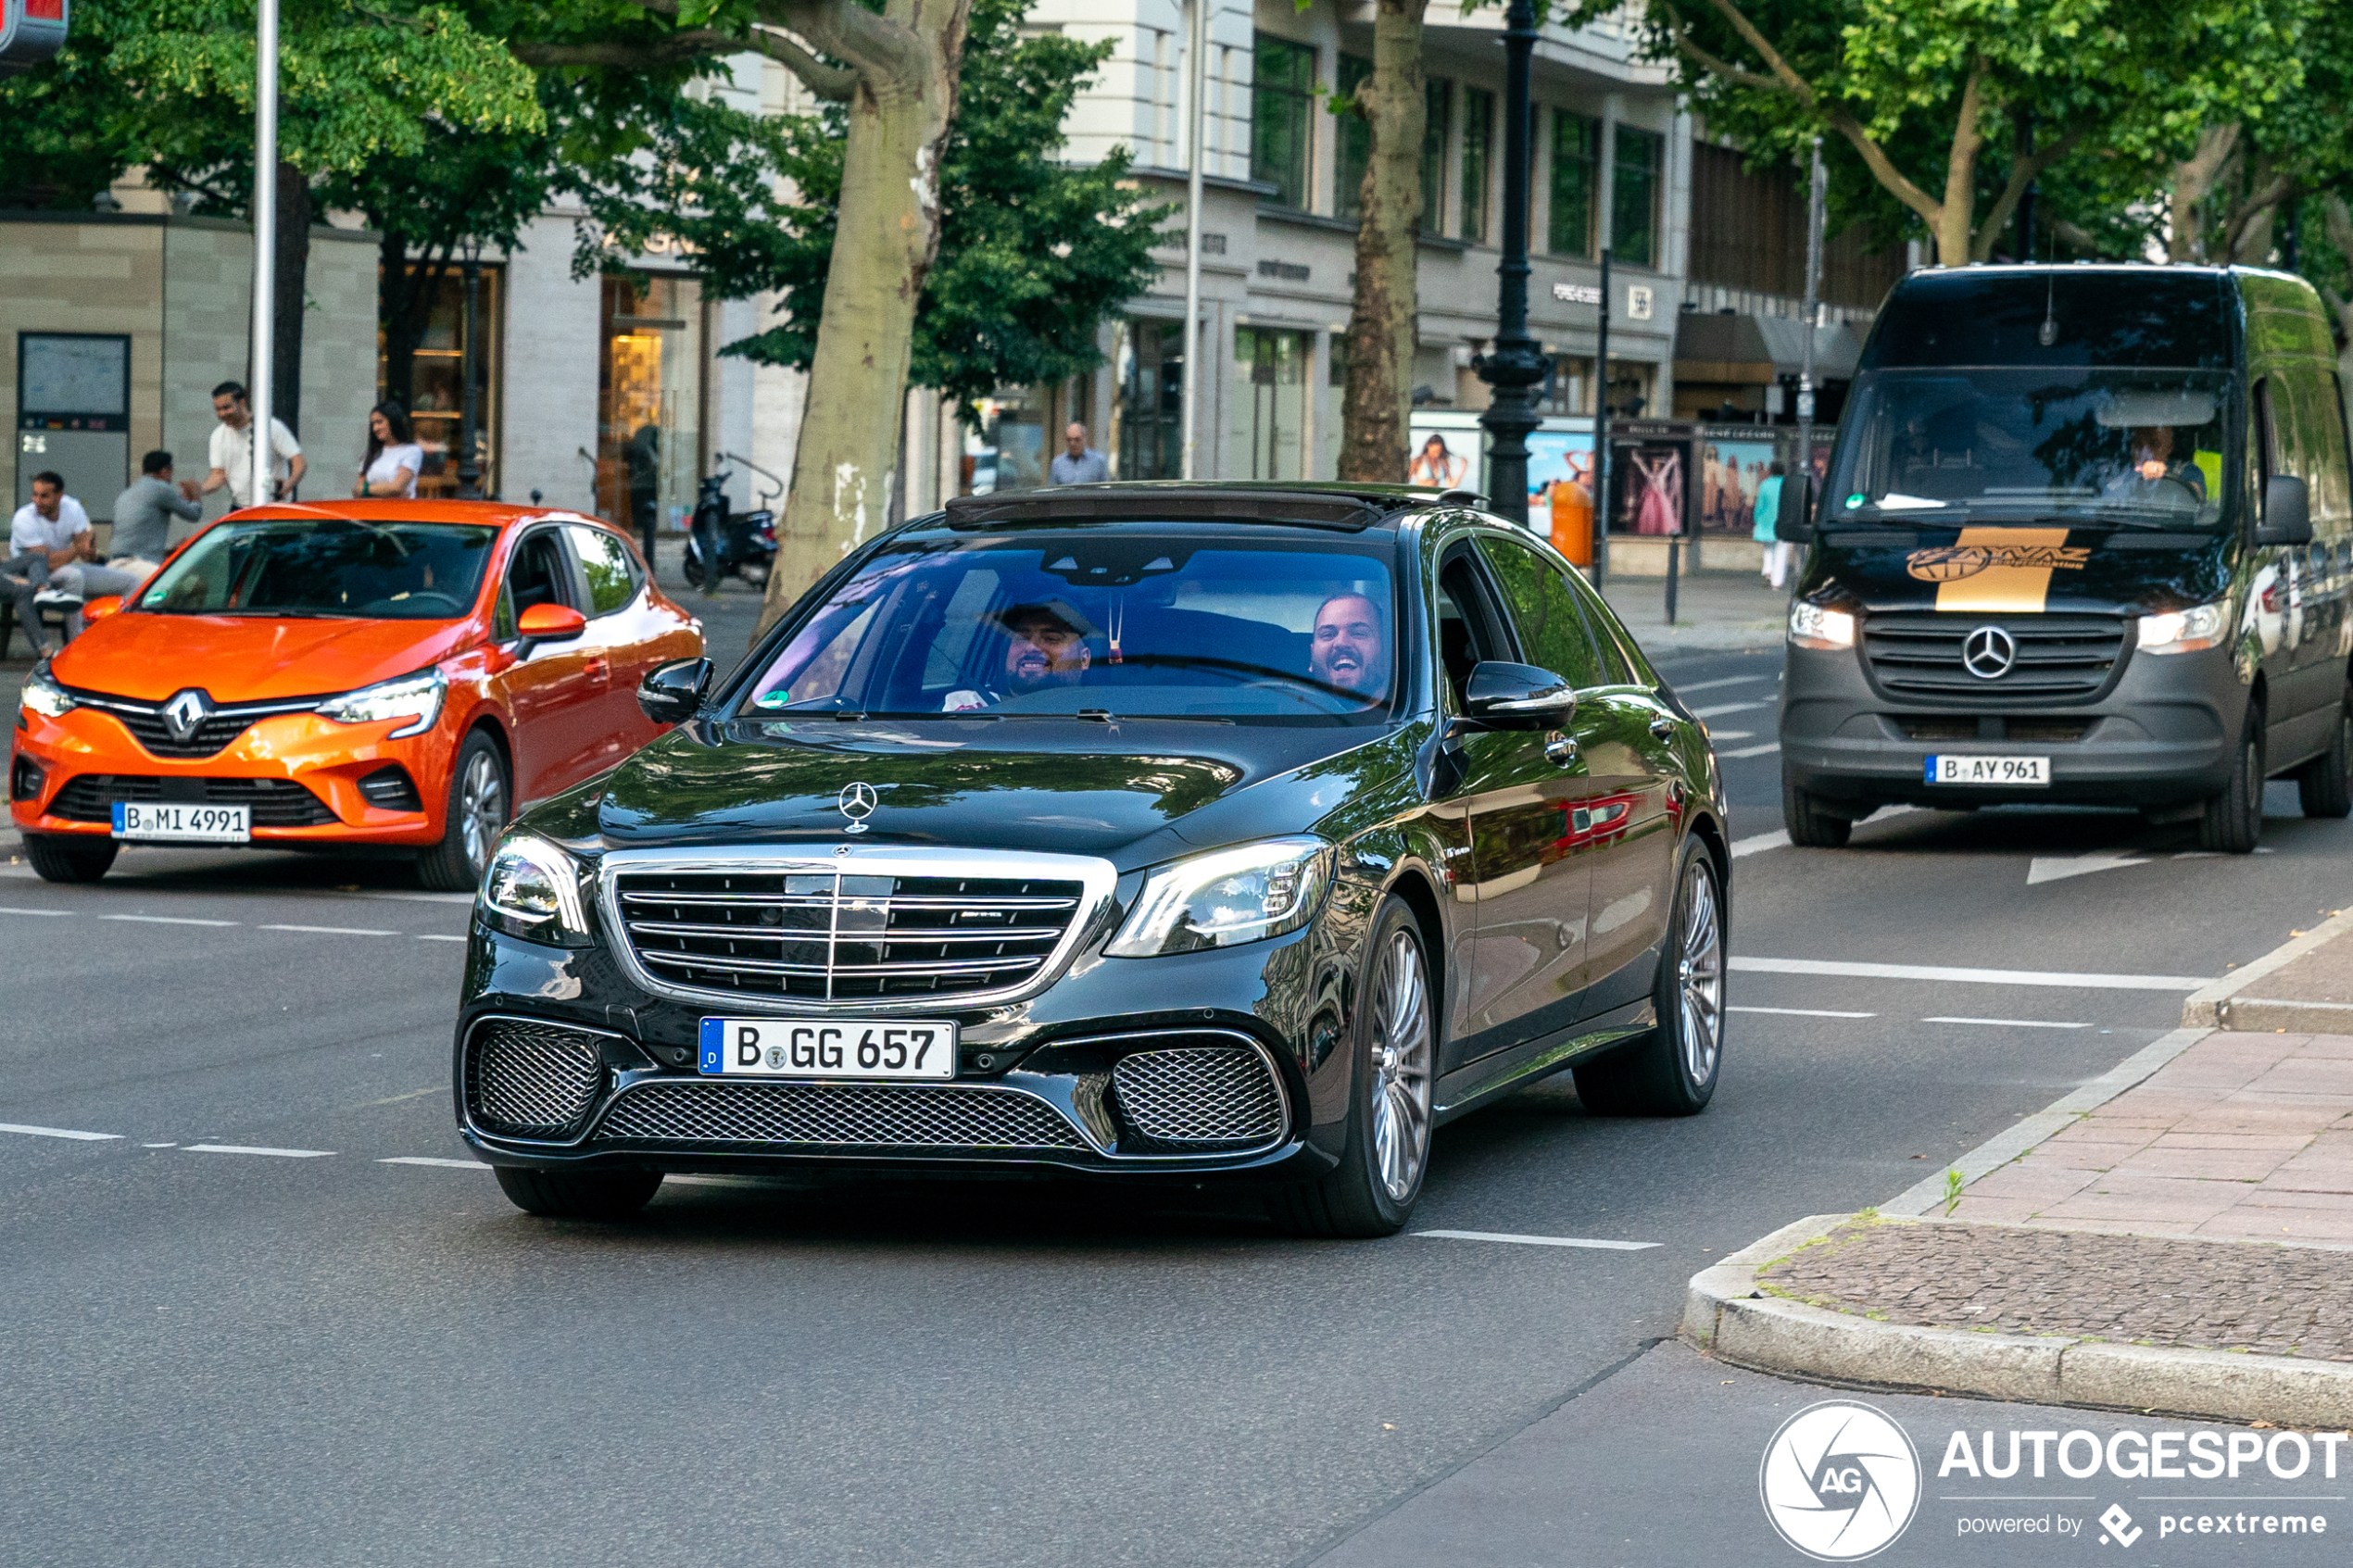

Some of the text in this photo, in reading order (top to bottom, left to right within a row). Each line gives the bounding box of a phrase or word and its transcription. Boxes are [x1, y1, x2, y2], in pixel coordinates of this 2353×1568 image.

[768, 691, 780, 700] 4
[1945, 760, 1957, 778] B
[1972, 760, 1997, 779] AY
[2004, 761, 2040, 779] 961
[127, 808, 140, 829] B
[157, 809, 183, 830] MI
[190, 809, 245, 832] 4991
[708, 1026, 935, 1070] D B GG 657
